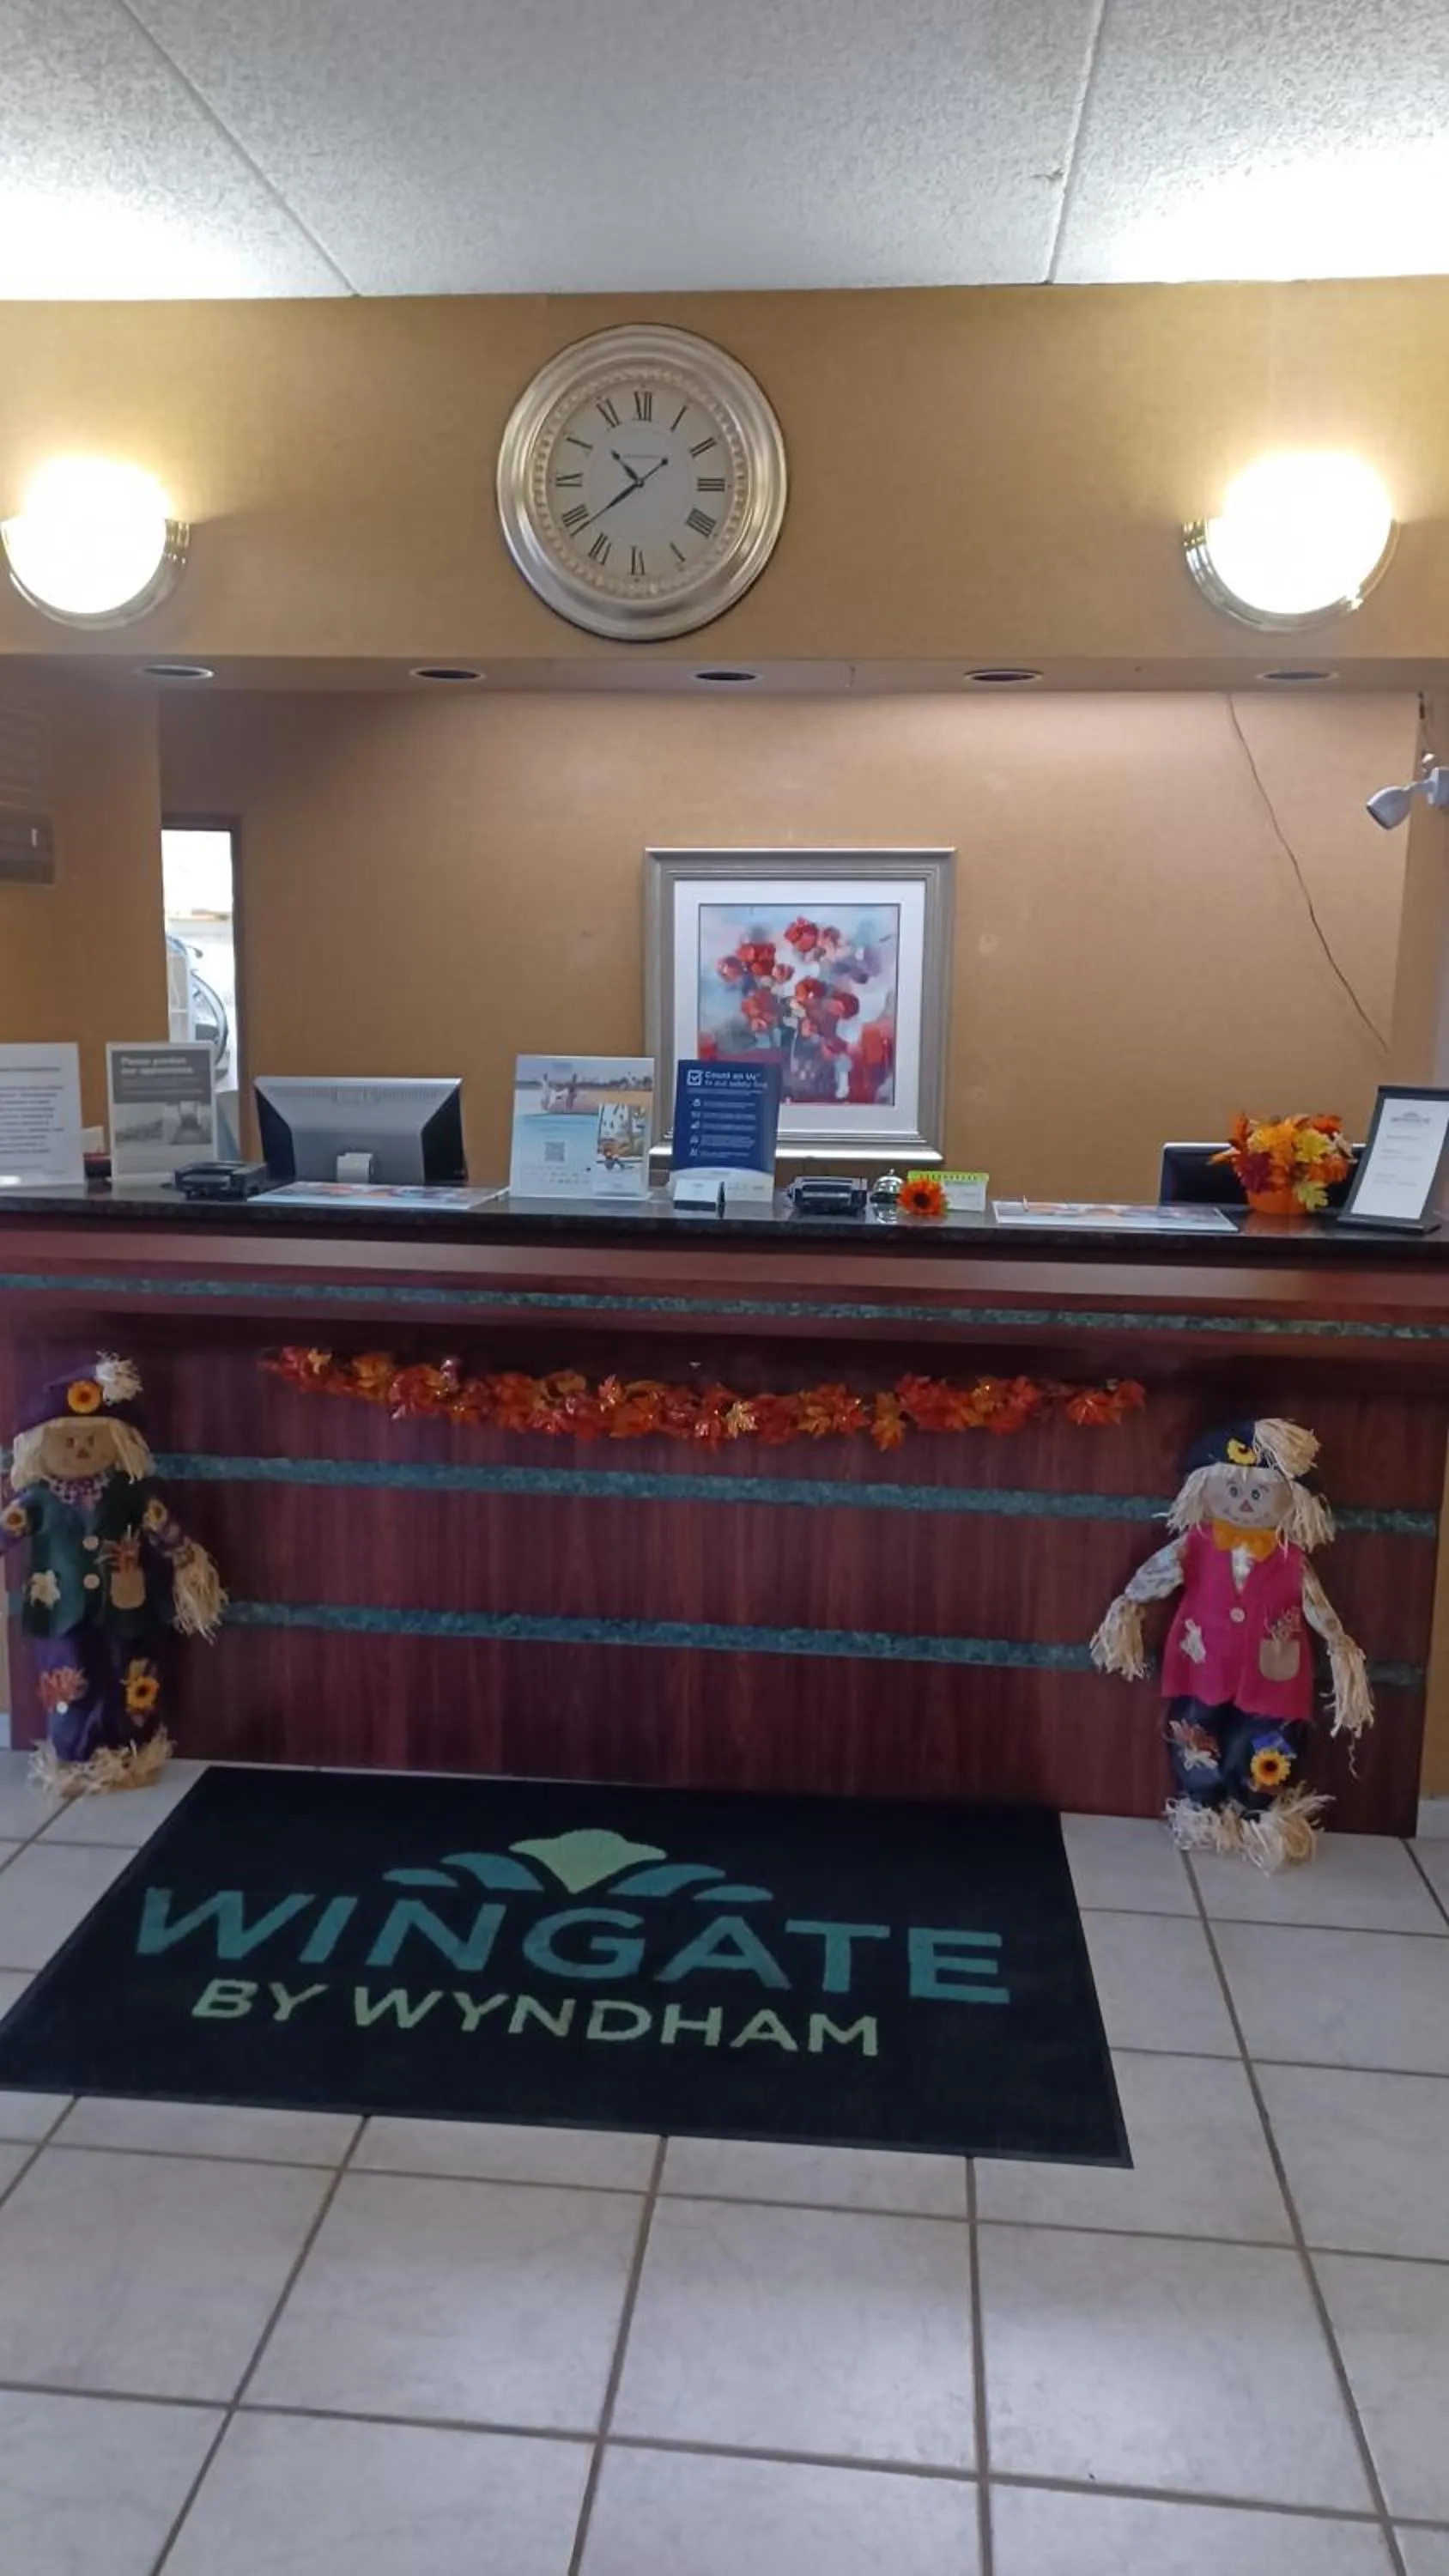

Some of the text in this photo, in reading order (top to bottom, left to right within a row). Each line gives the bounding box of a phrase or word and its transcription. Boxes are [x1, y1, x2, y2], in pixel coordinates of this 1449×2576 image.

[136, 1887, 1009, 2003] WINGATE
[191, 1978, 879, 2057] BY WYNDHAM
